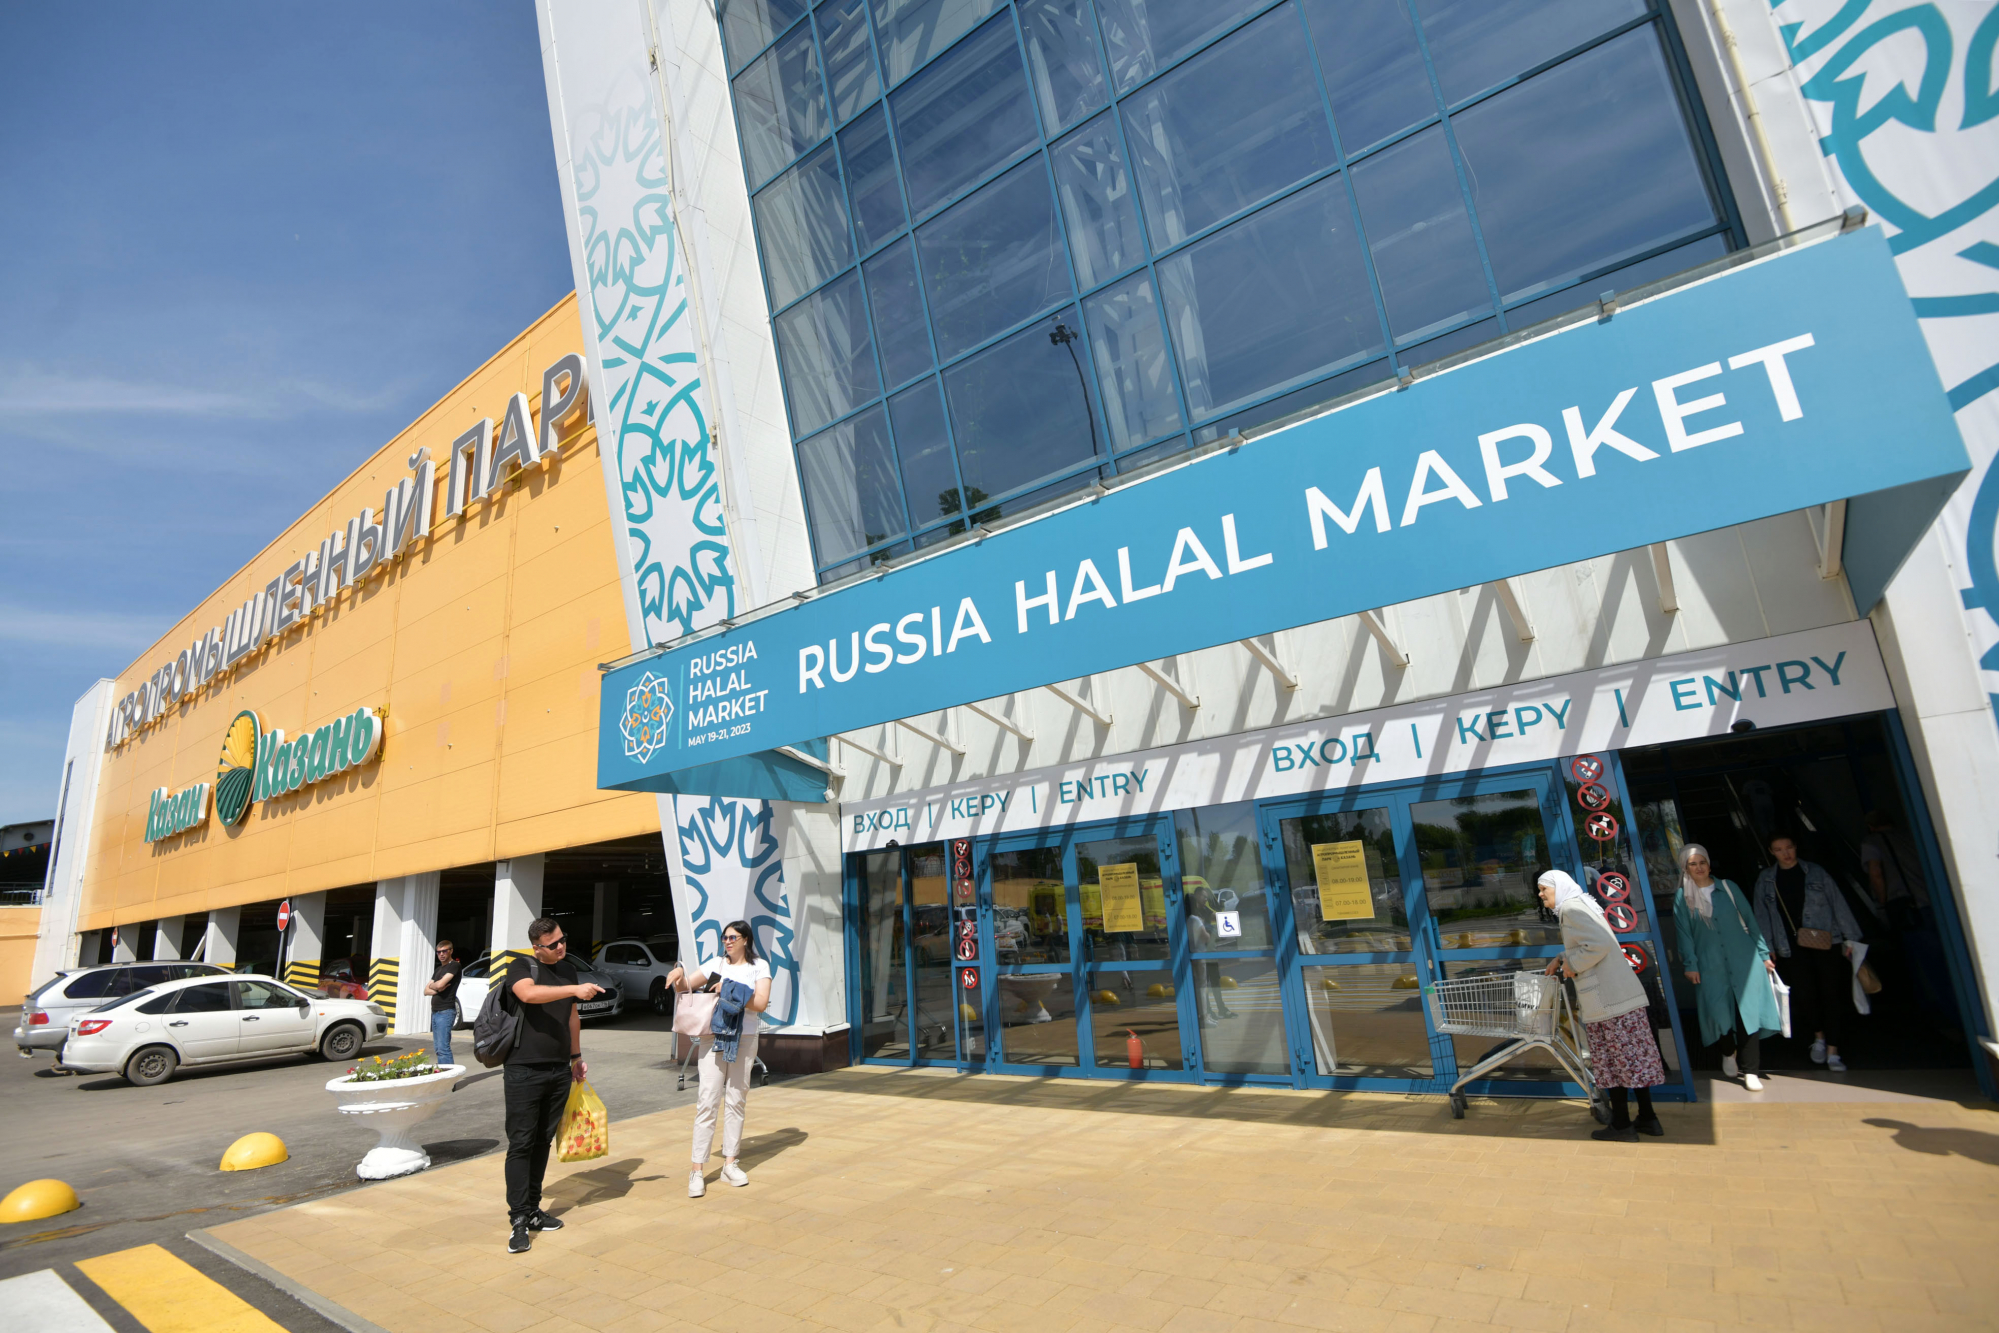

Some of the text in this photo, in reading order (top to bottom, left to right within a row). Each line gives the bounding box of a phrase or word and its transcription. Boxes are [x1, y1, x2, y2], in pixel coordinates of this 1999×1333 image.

[799, 332, 1816, 694] RUSSIA HALAL MARKET
[105, 353, 596, 749] АГРОПРОМЫШЛЕННЫЙ ПАР
[688, 669, 752, 704] HALAL
[689, 640, 758, 679] RUSSIA
[688, 690, 769, 730] MARKET
[688, 722, 751, 747] MAY 19-21, 2023
[1271, 733, 1380, 773] ВХОД
[1669, 651, 1847, 712] ENTRY
[144, 707, 381, 843] Казан Казань
[853, 807, 911, 834] ВХОД
[1059, 768, 1149, 804] ENTRY
